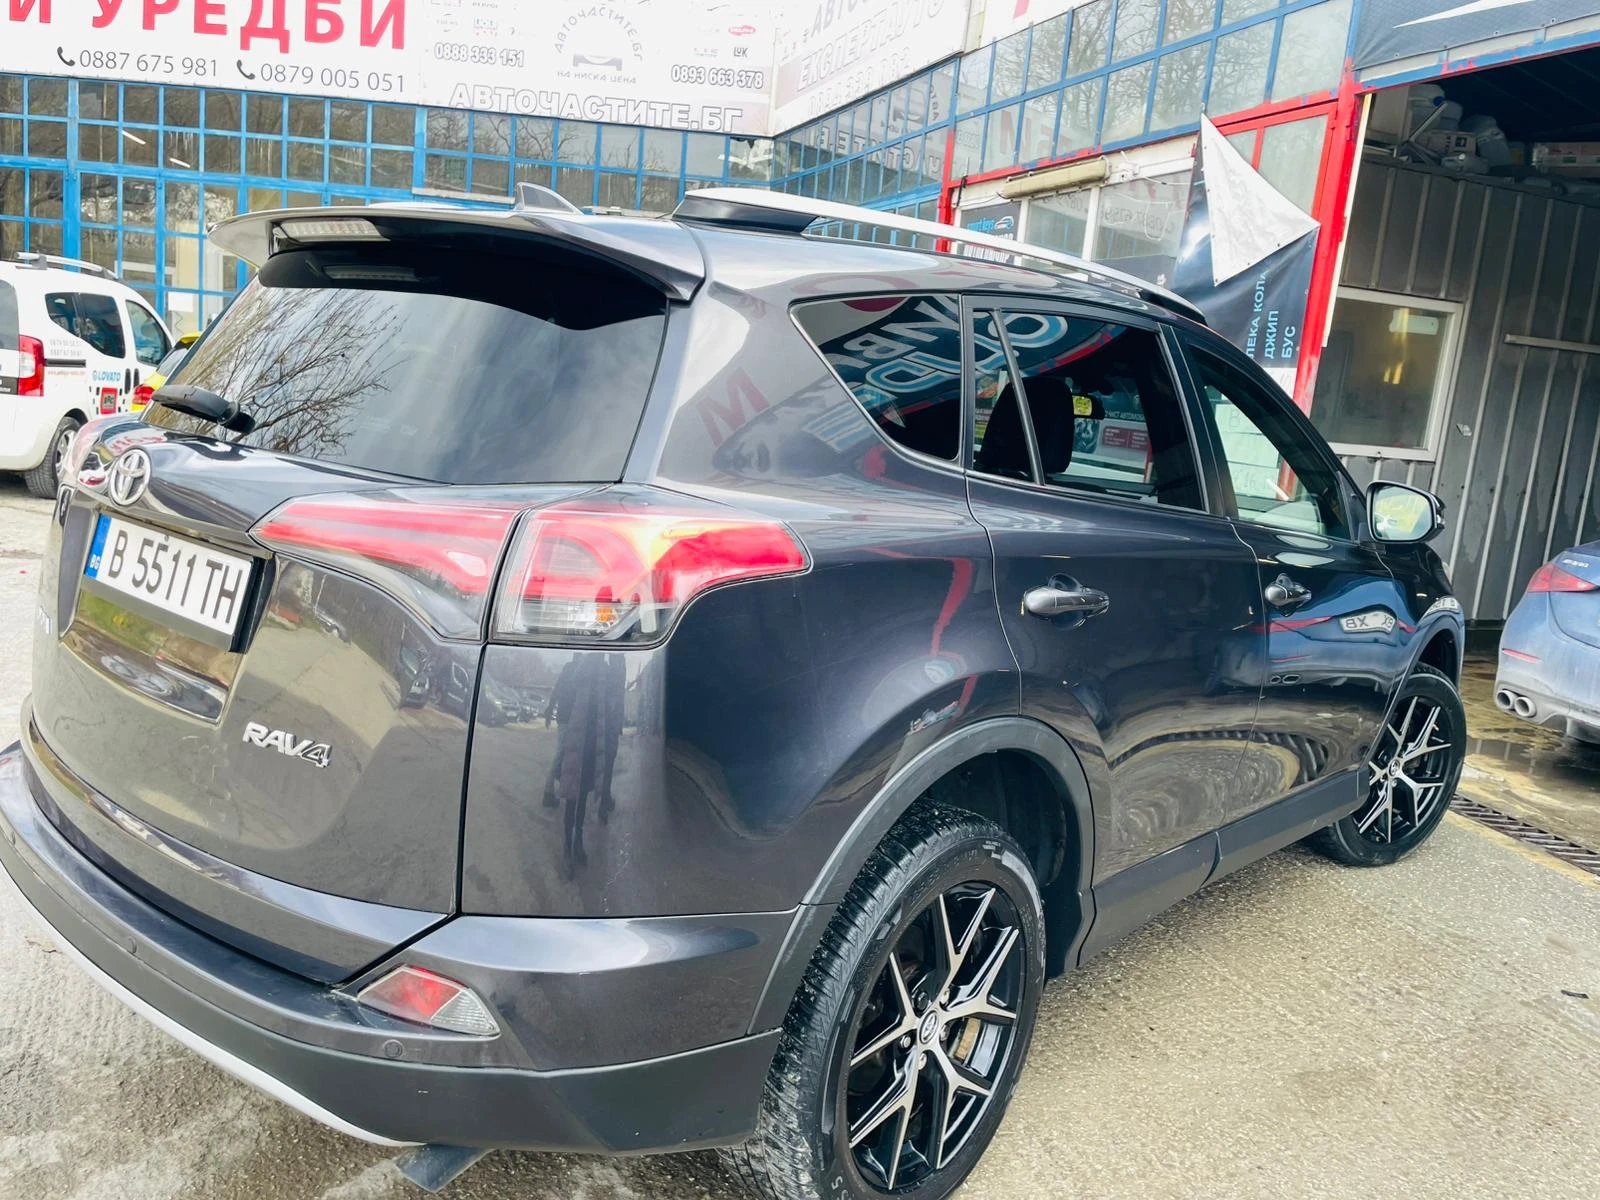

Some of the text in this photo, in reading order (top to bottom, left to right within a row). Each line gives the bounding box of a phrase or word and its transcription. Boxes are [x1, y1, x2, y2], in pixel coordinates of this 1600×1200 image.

[91, 0, 406, 54] УРЕДБИ
[79, 49, 217, 77] 0887 675 981
[434, 41, 525, 68] 0888 333 151
[260, 63, 404, 93] 0879 005 051
[671, 64, 764, 89] 0893 663 378
[448, 83, 743, 133] АВТОЧАСТИТЕ.БГ
[1245, 316, 1261, 359] ЛЕКА
[1264, 310, 1279, 359] ДЖИП
[1281, 325, 1296, 358] БУС
[98, 370, 121, 382] LOVATO
[89, 554, 101, 570] BG
[108, 529, 243, 624] B 5511 TH
[242, 721, 332, 768] RAV4
